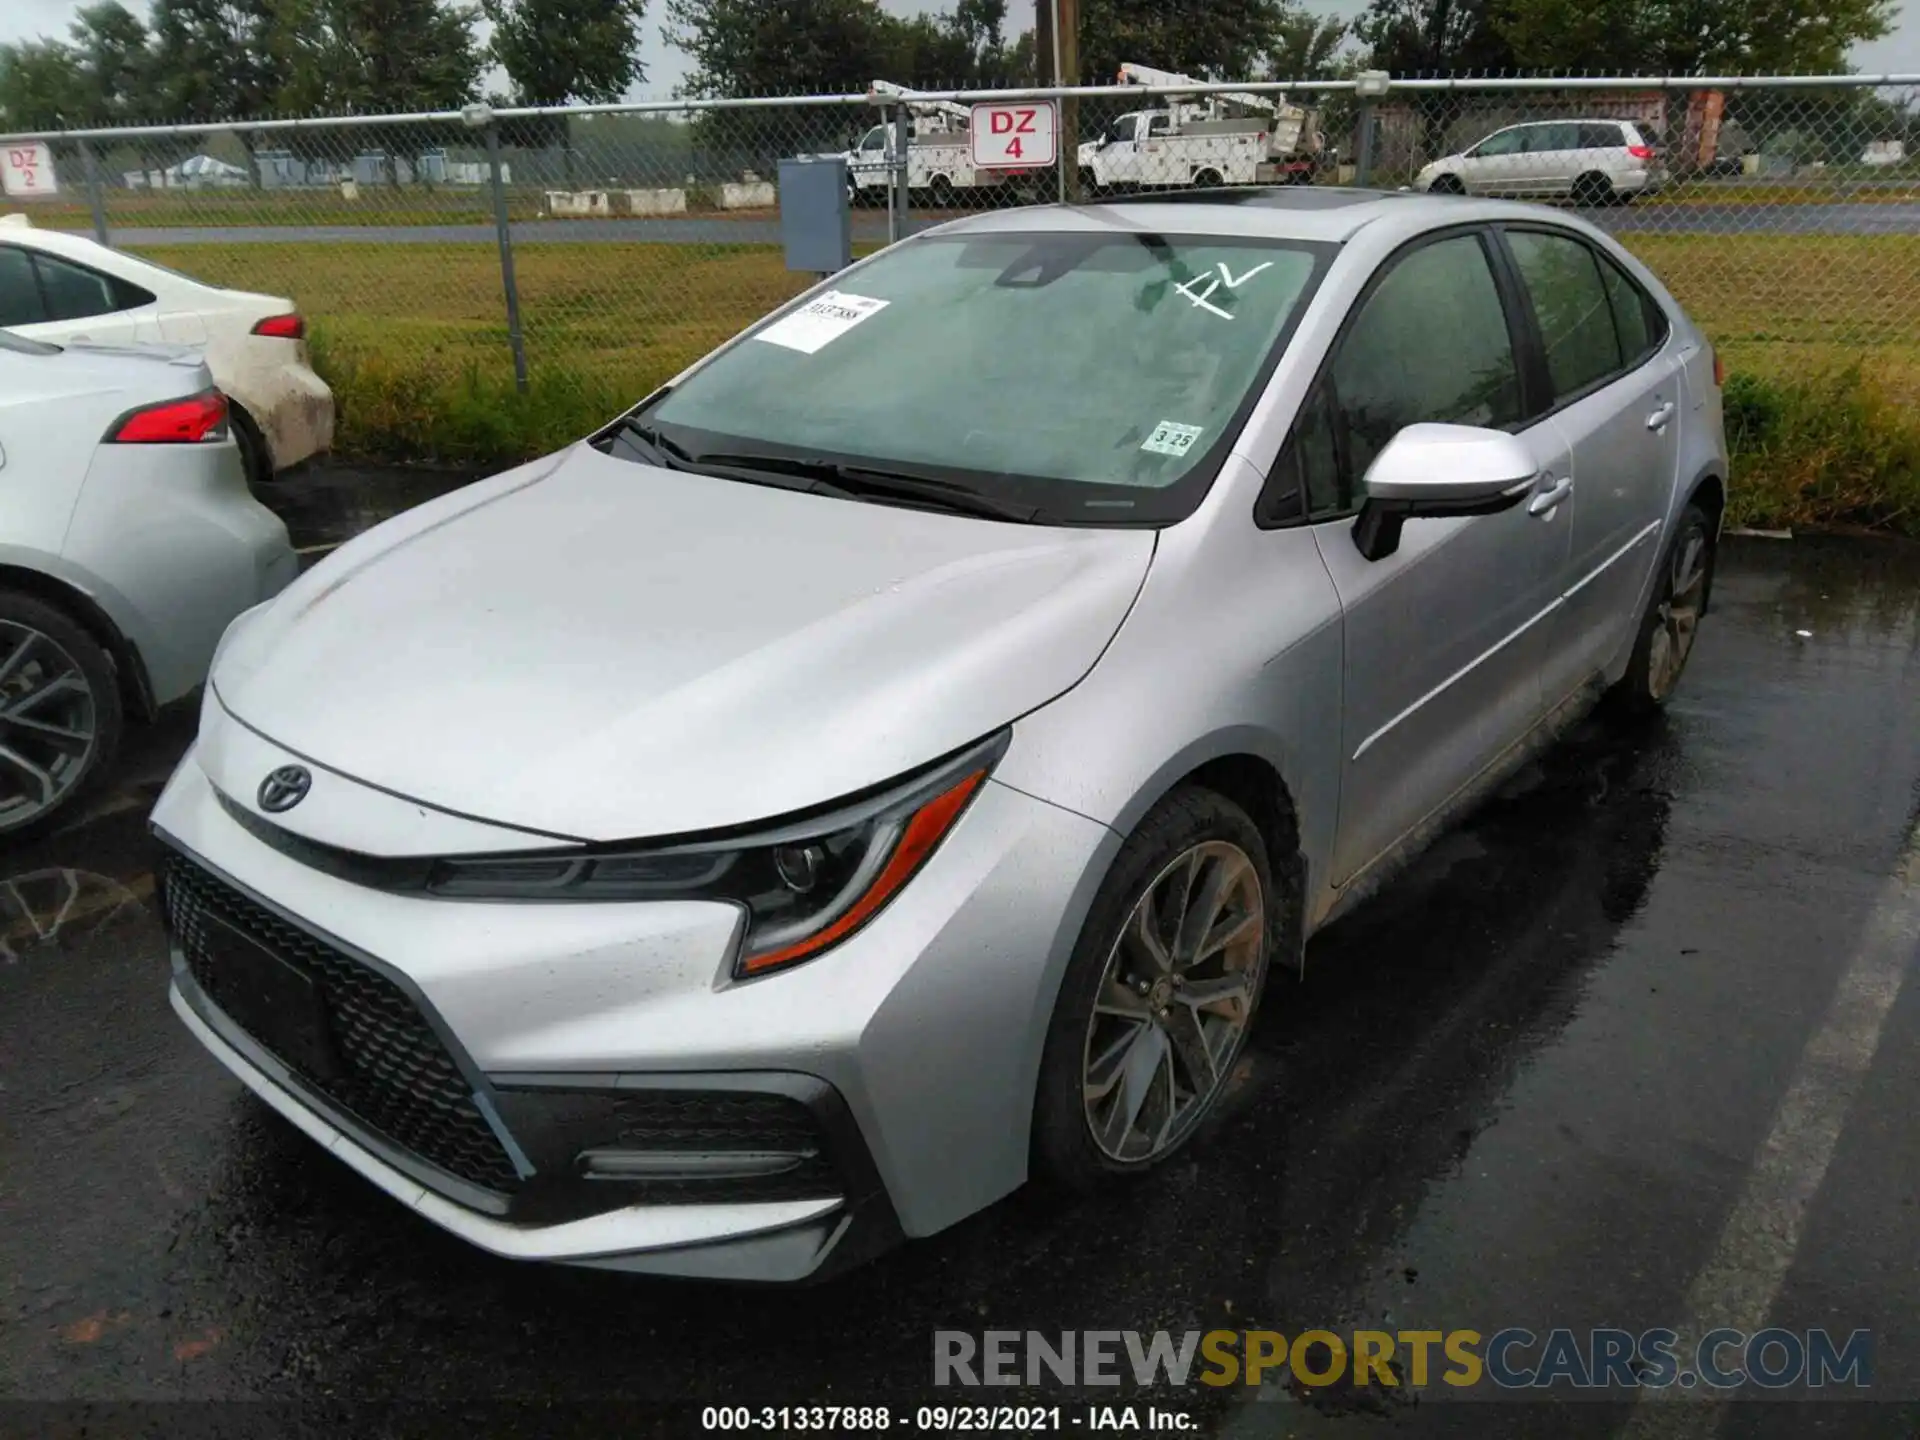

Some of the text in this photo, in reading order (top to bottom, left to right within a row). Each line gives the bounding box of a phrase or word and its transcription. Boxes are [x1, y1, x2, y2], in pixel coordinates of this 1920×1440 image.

[990, 110, 1036, 134] DZ
[1005, 136, 1024, 159] 4
[9, 149, 39, 169] DZ
[24, 170, 35, 187] 2
